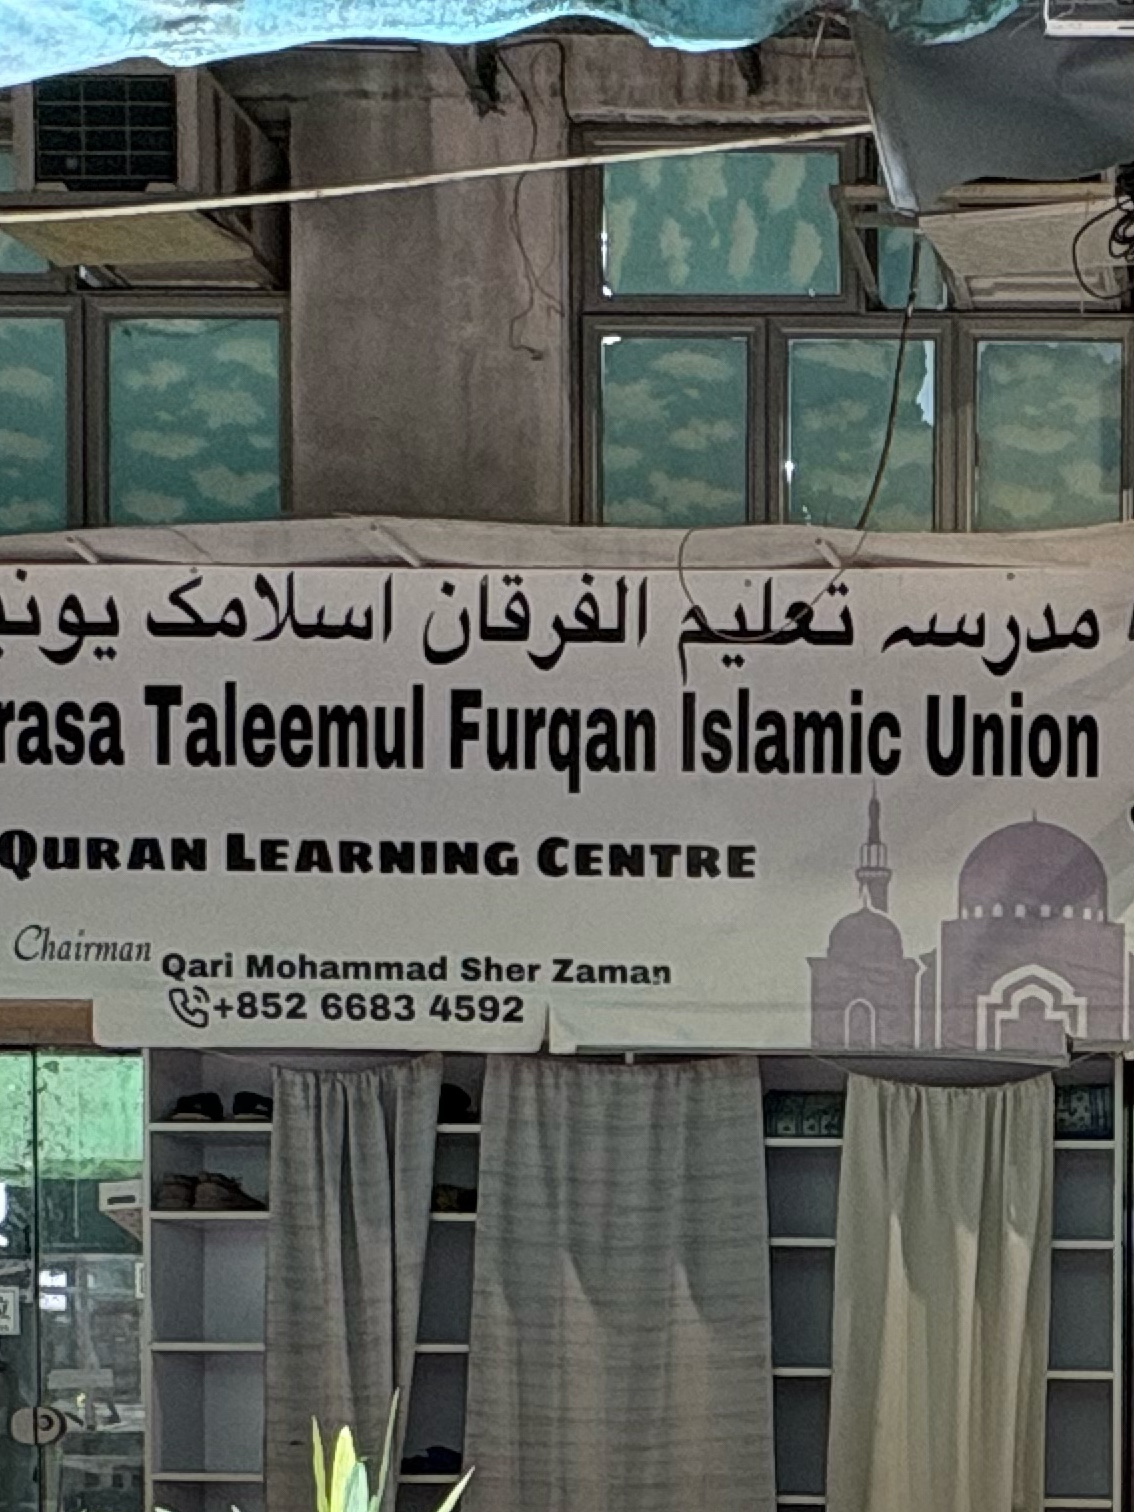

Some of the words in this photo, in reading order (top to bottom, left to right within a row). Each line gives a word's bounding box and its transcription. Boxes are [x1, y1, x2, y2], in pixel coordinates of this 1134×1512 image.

[422, 572, 648, 671] الفرقان
[144, 681, 424, 769] Taleemul
[450, 688, 656, 793] Furqan
[681, 687, 902, 776] Islamic
[926, 691, 1099, 777] Union
[0, 829, 207, 881] QURAN
[226, 833, 519, 876] LEARNING
[537, 836, 756, 878] CENTRE
[13, 924, 152, 962] Chairman
[162, 953, 233, 982] Qari
[246, 954, 448, 982] Mohammad
[460, 957, 541, 983] Sher
[551, 958, 672, 985] Zaman
[213, 991, 308, 1020] +852
[321, 993, 416, 1021] 6683
[429, 995, 524, 1023] 4592
